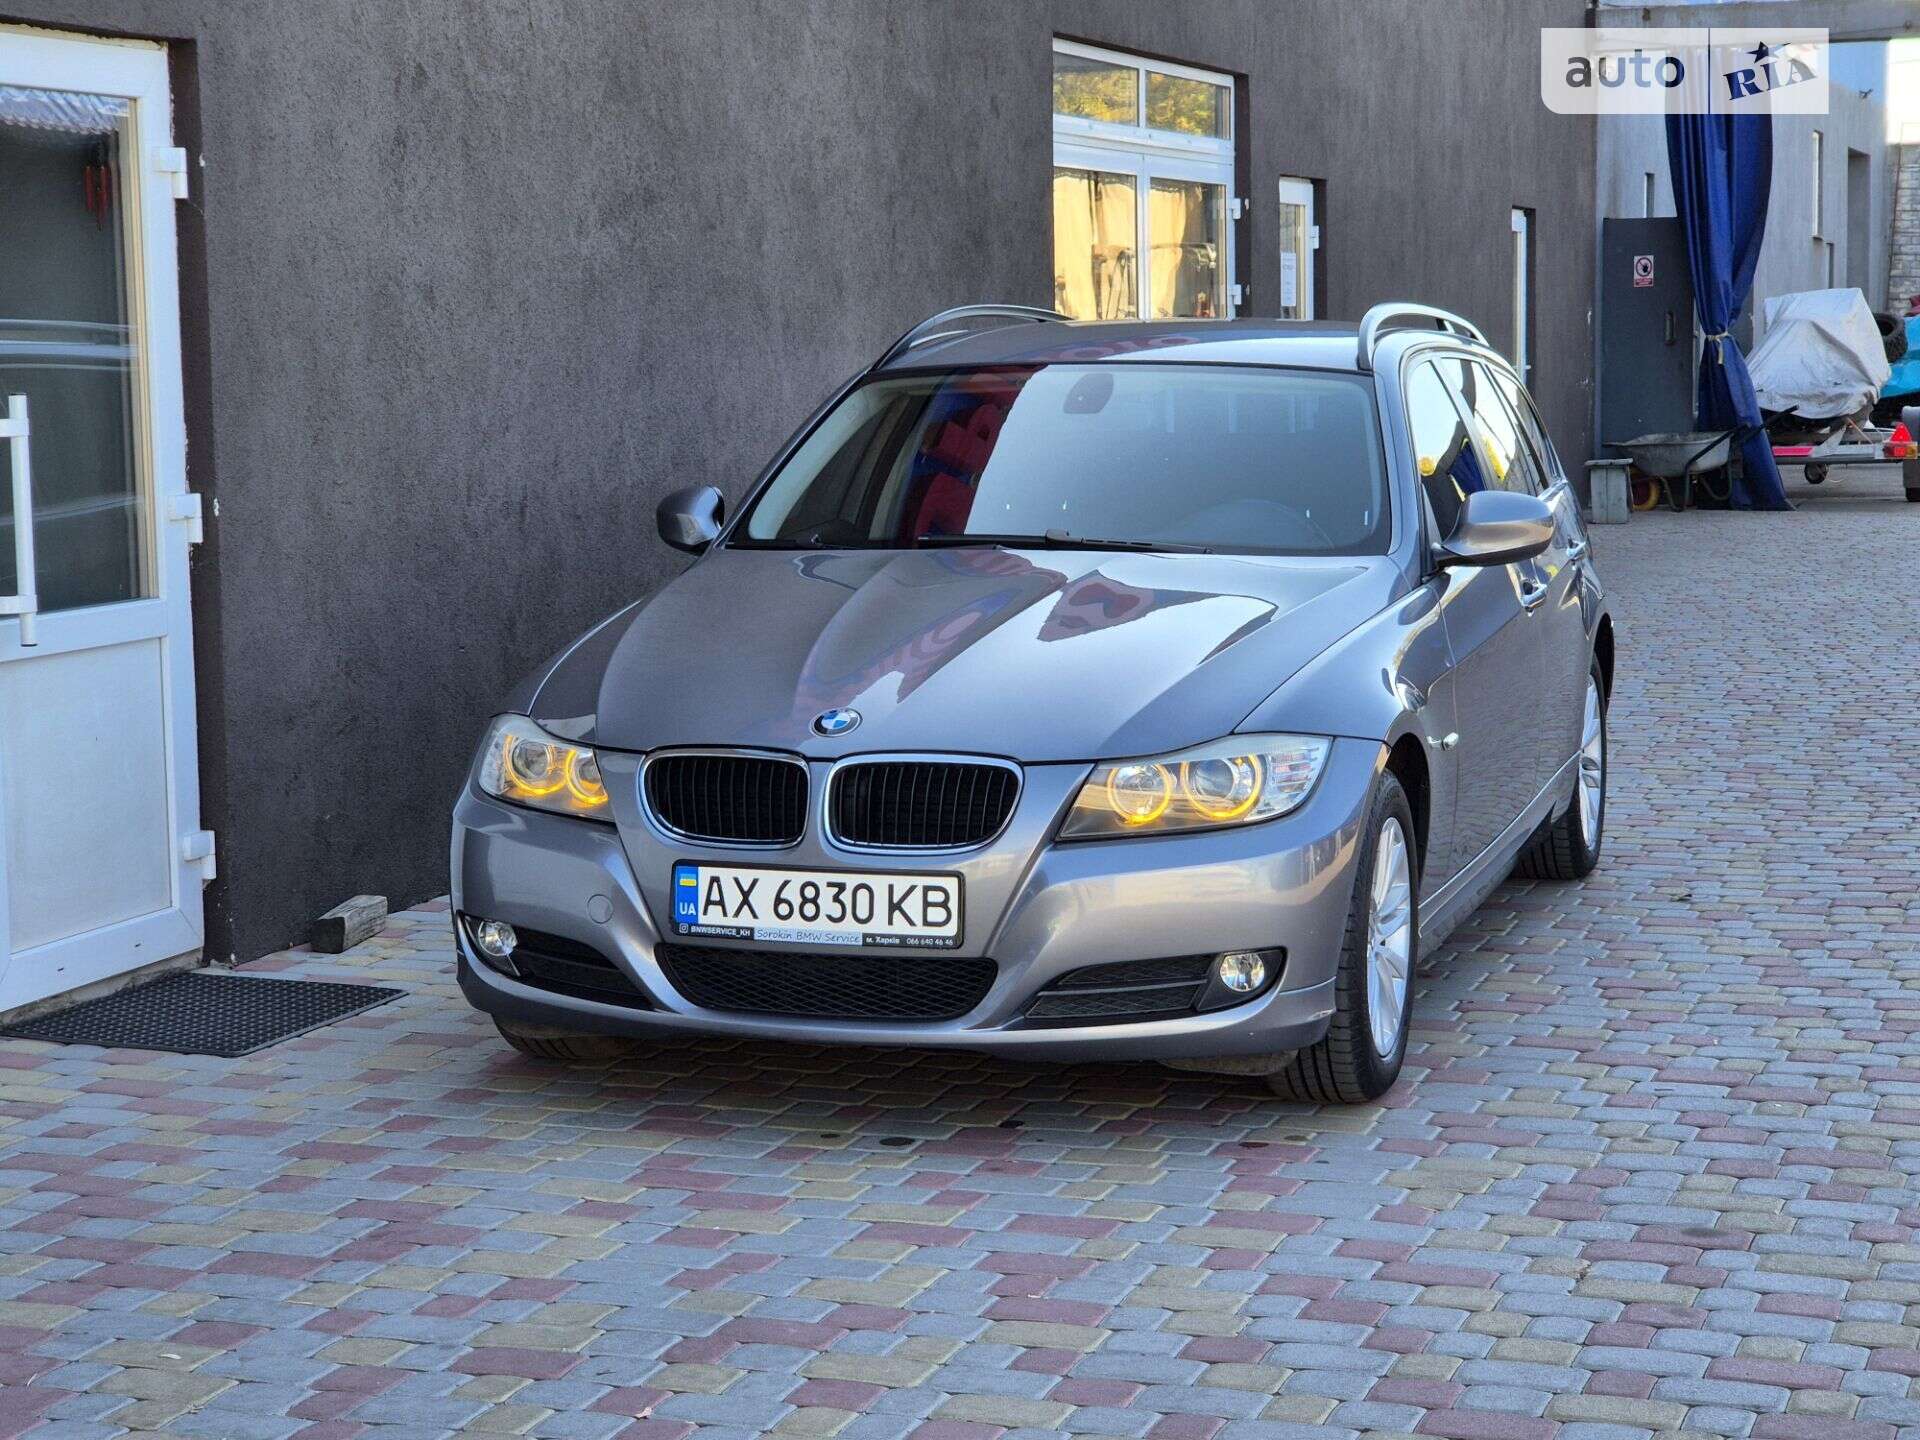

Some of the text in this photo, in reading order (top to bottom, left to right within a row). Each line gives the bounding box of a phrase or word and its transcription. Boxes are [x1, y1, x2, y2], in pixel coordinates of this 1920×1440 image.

[679, 901, 697, 916] UA
[702, 876, 953, 928] AX 6830 KB
[756, 929, 860, 945] Sorokin BMW Service
